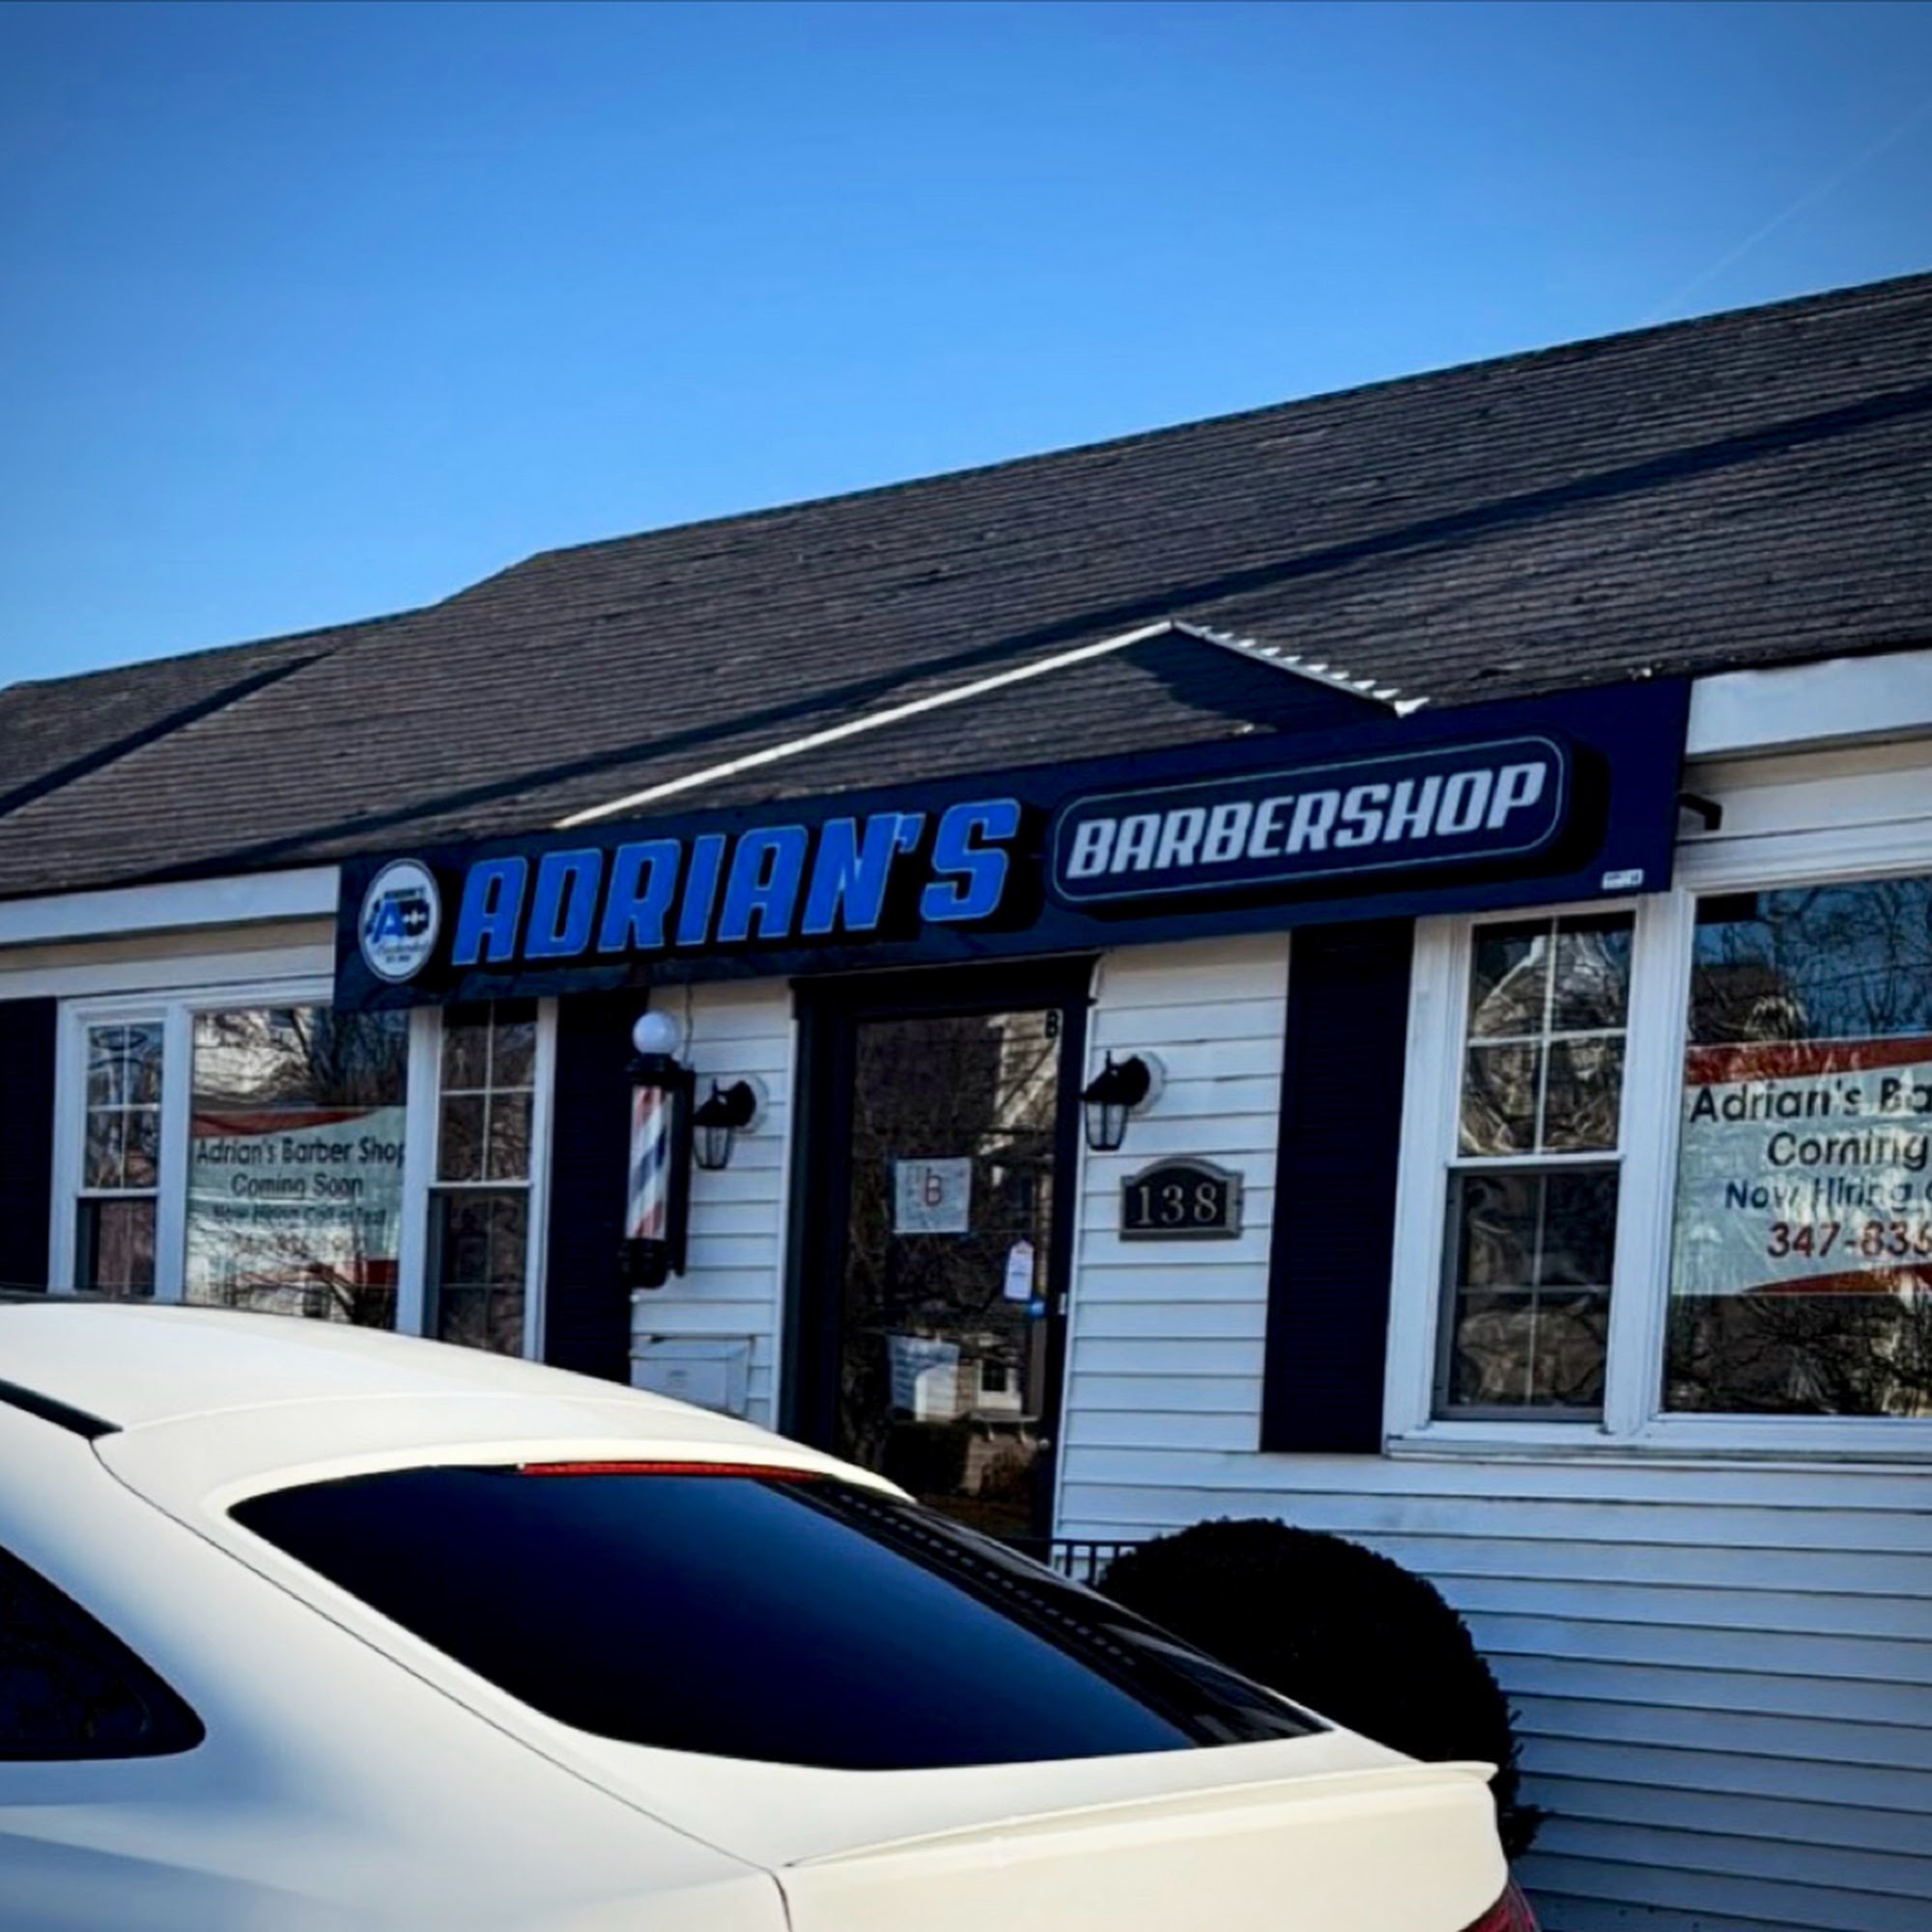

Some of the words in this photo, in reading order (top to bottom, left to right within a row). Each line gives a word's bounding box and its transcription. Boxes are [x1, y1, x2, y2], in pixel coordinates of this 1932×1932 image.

[451, 798, 1021, 966] ADRIAN'S
[1065, 761, 1547, 879] BARBERSHOP
[1690, 1077, 1862, 1122] Adrian's
[196, 1136, 277, 1165] Adrian's
[281, 1135, 353, 1165] Barber
[1767, 1127, 1929, 1172] Coming
[231, 1172, 306, 1201] Coming
[313, 1172, 363, 1198] Soon
[1134, 1181, 1218, 1226] 138
[1724, 1179, 1800, 1209] Now
[1811, 1176, 1913, 1212] Hiring
